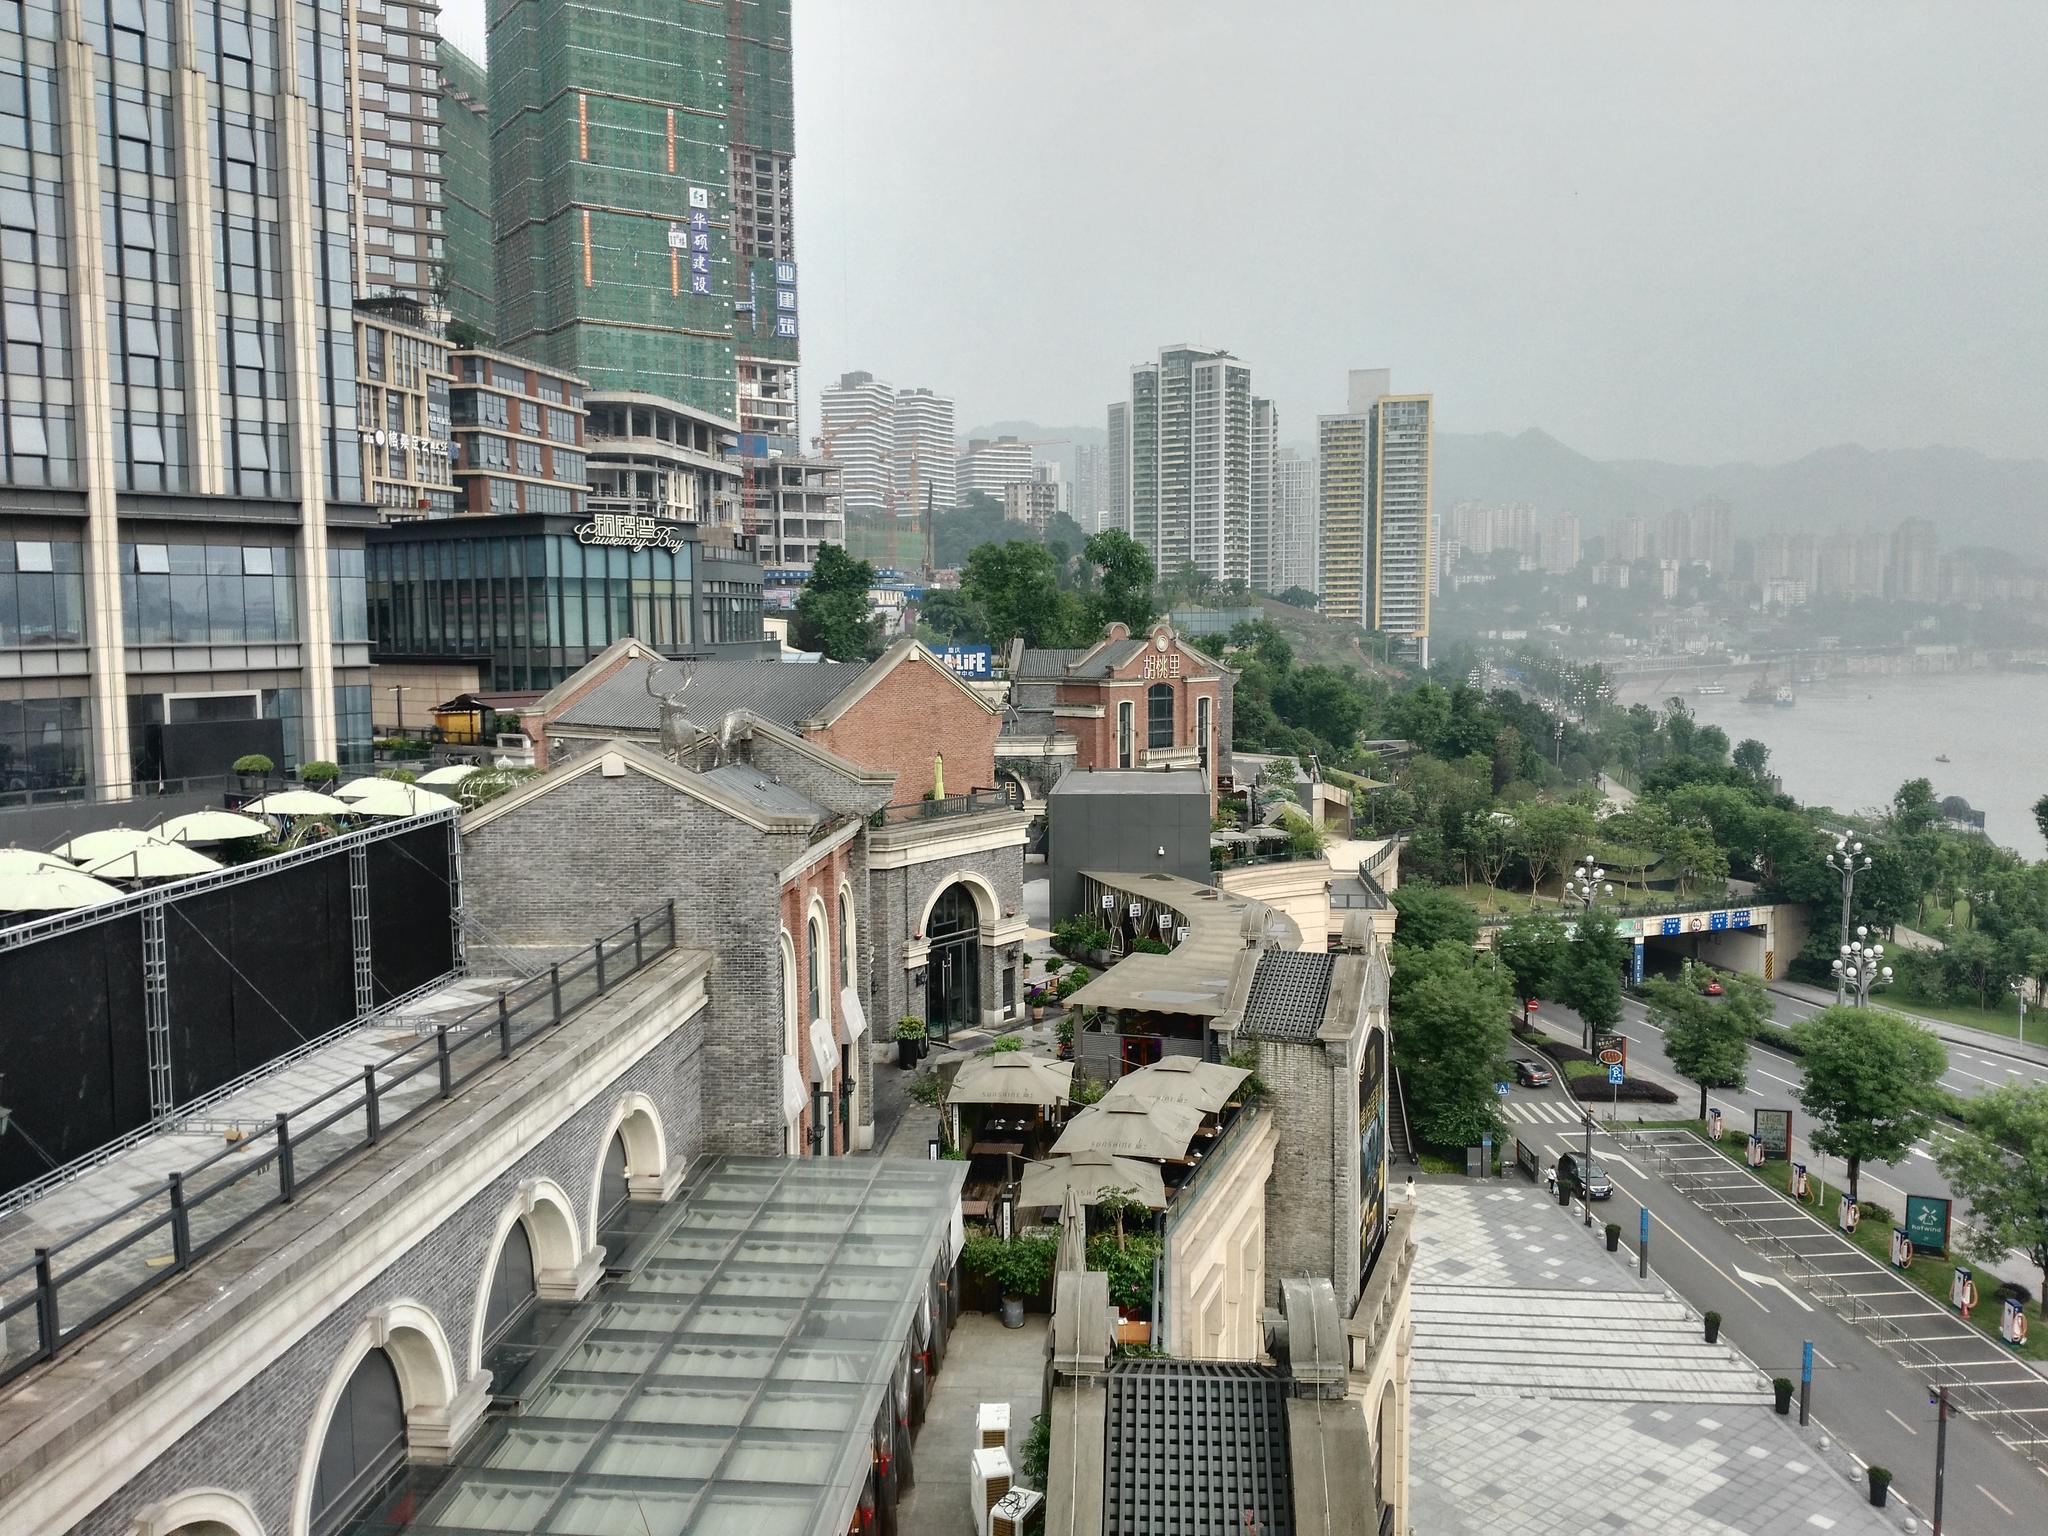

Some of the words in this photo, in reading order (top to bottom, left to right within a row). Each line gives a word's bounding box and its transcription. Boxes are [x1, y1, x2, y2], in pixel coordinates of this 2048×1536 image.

[692, 212, 709, 294] 华硕建设
[574, 522, 647, 553] Causeway
[647, 526, 684, 554] Bay
[594, 513, 656, 539] 铜锣湾
[1143, 654, 1181, 679] 胡桃里
